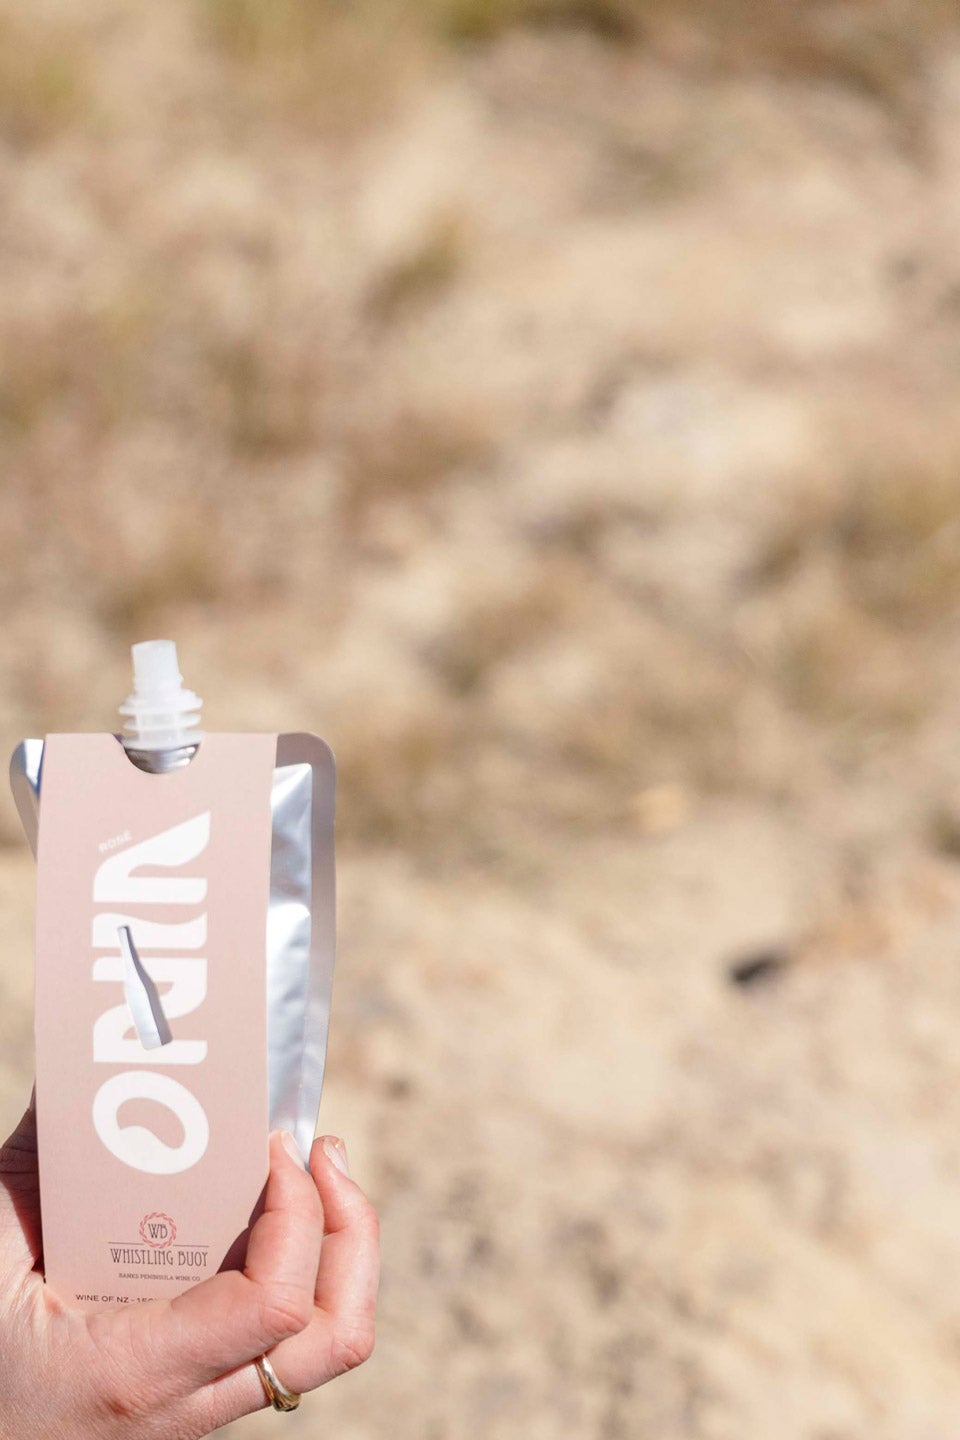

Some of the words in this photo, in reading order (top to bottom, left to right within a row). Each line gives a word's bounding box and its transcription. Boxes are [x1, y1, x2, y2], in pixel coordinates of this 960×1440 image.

[148, 1223, 168, 1239] WB
[110, 1248, 174, 1266] WHISTLING
[178, 1250, 208, 1267] BUOY
[75, 1294, 99, 1302] WINE
[101, 1295, 115, 1303] OF
[116, 1296, 129, 1304] NZ
